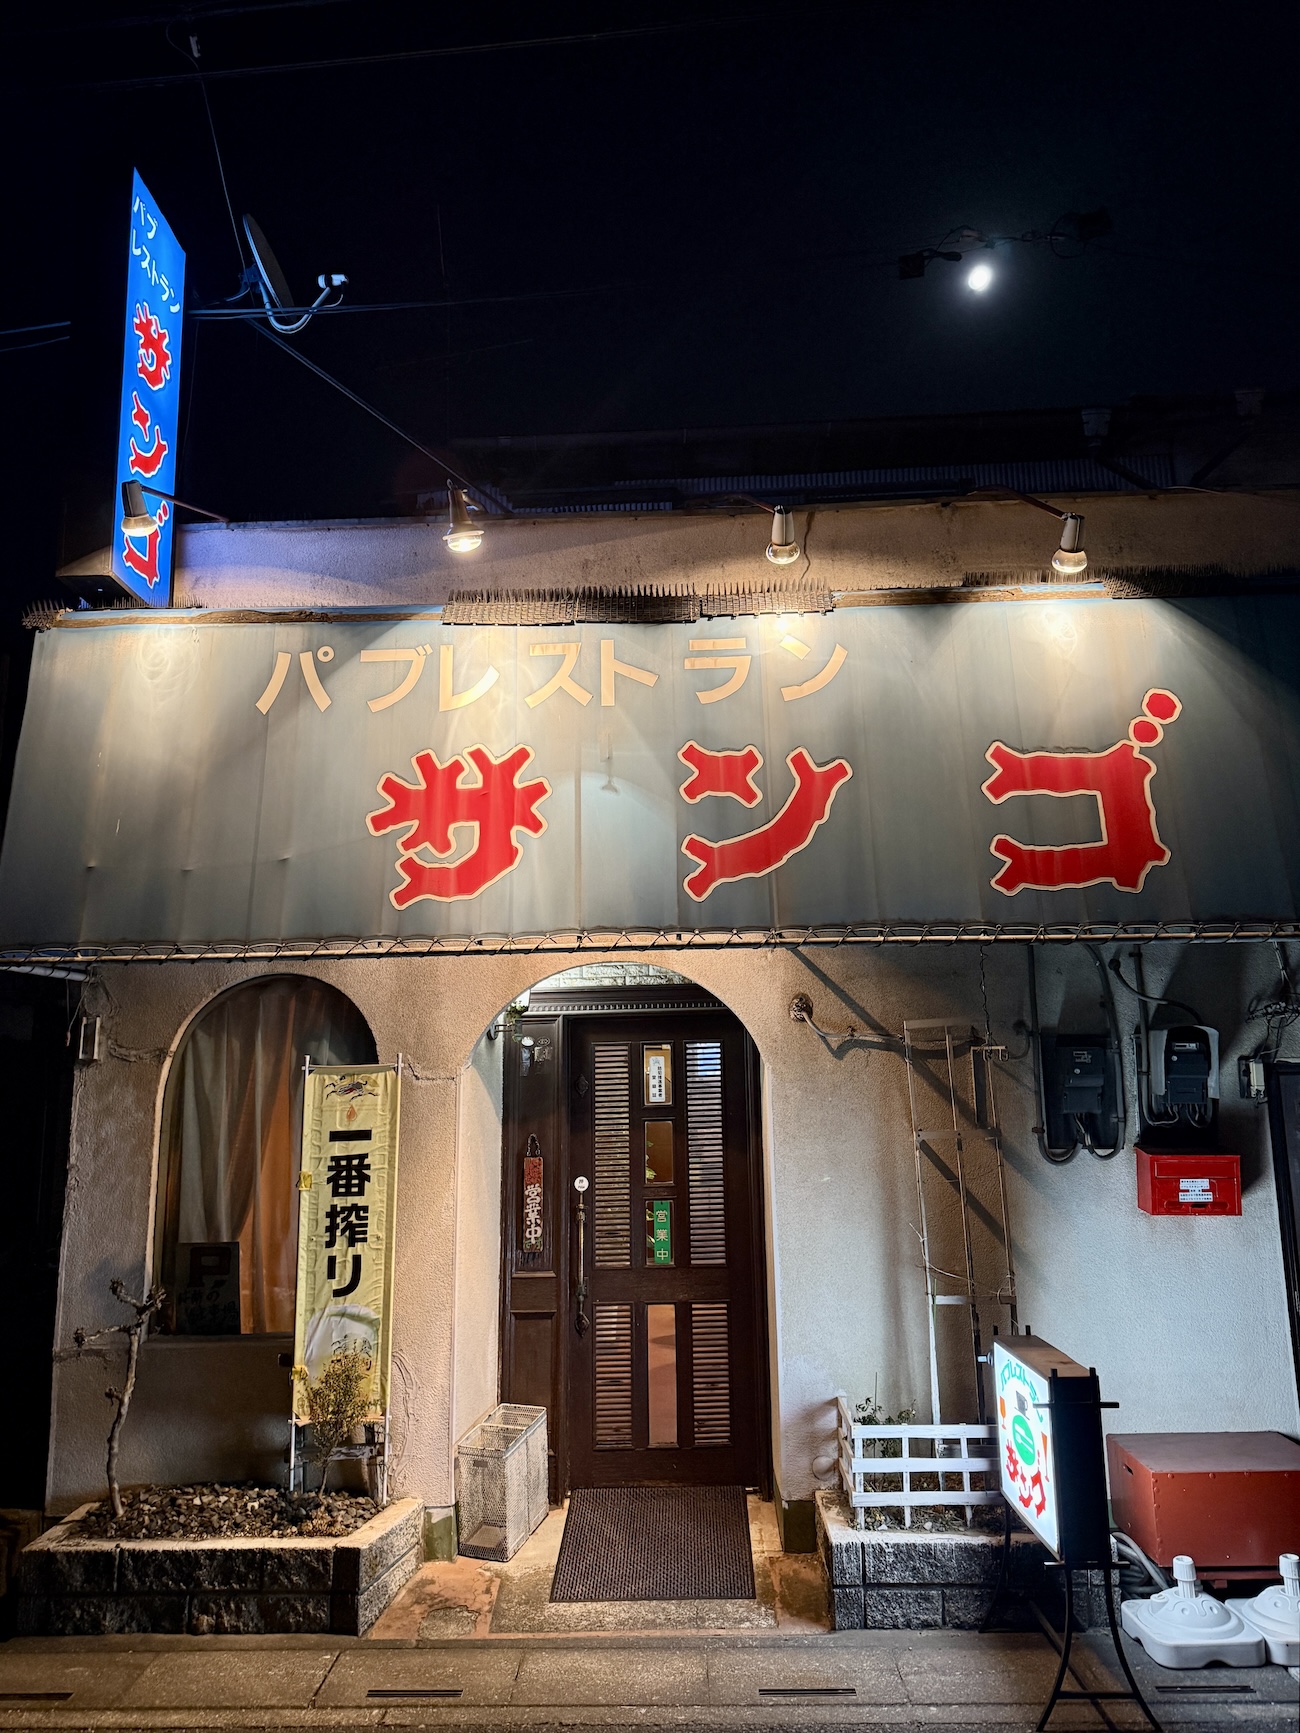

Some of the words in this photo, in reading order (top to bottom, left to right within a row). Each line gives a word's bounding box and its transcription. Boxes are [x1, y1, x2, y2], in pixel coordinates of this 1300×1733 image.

[132, 228, 180, 313] レストラン
[255, 634, 848, 716] パブレストラン
[366, 688, 1182, 910] サンゴ
[324, 1129, 373, 1298] 一番搾り
[524, 1183, 543, 1244] 営業中
[655, 1210, 668, 1260] 営業中
[1006, 1439, 1047, 1519] サンゴ
